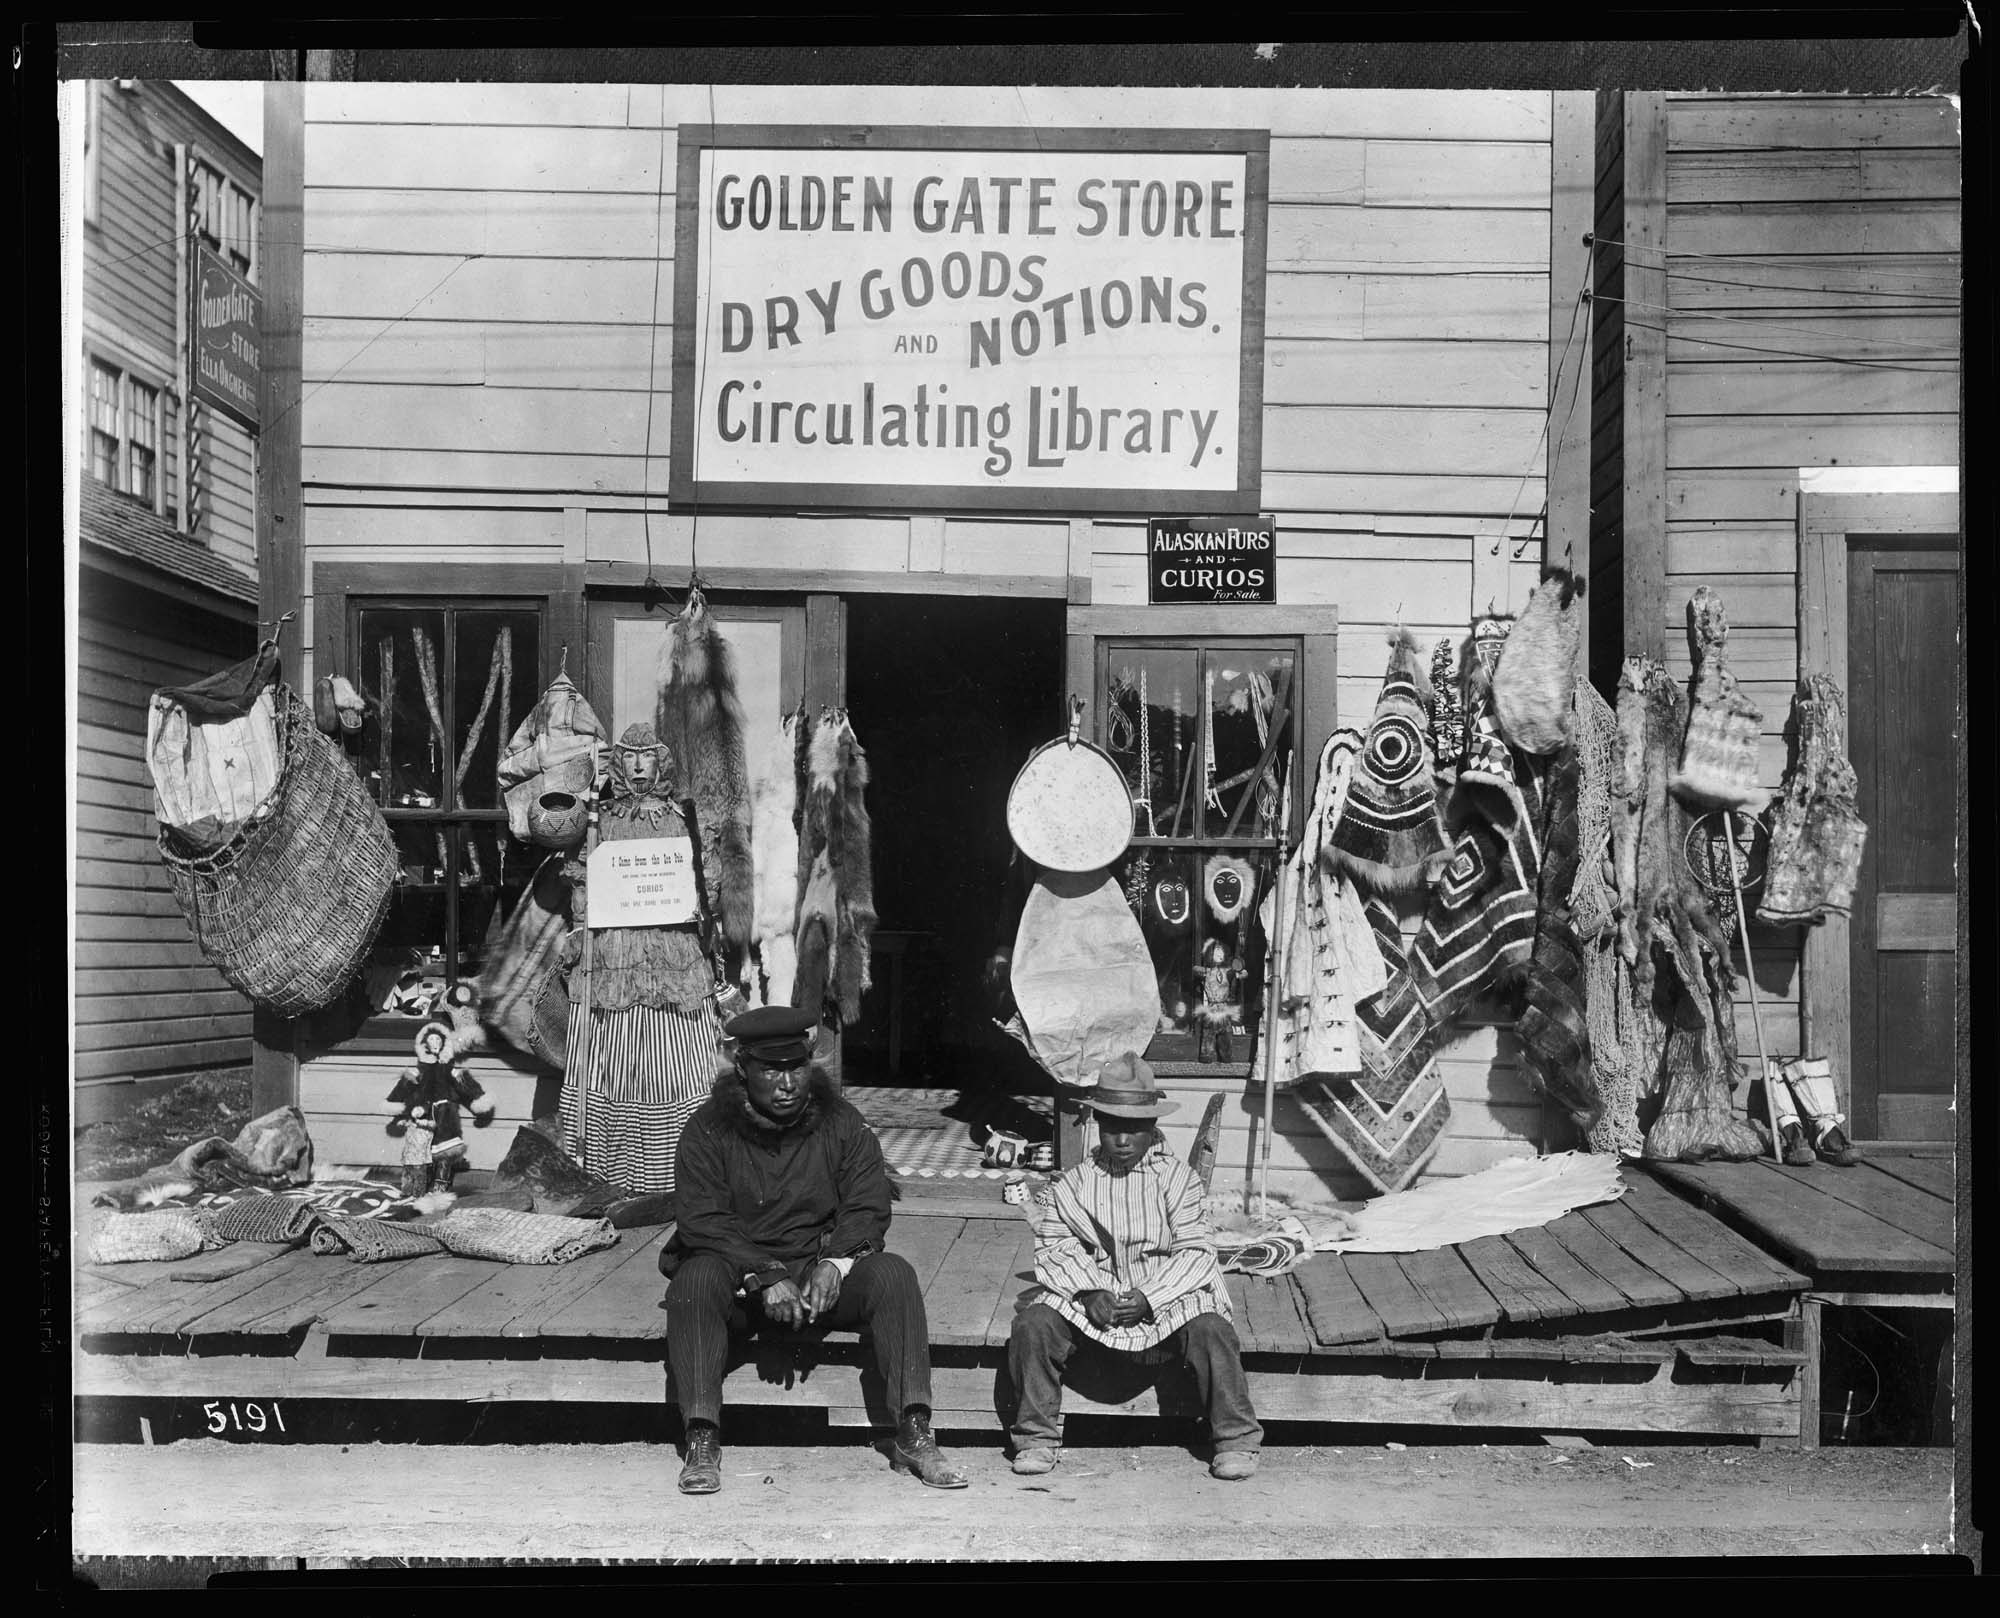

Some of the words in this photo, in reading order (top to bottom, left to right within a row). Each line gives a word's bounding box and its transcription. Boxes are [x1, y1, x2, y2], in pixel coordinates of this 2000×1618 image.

[716, 174, 894, 232] GOLDEN
[912, 176, 1057, 236] GATE
[201, 278, 231, 329] GOLDEN
[231, 282, 255, 328] GATE
[720, 279, 842, 354] DRY
[859, 250, 1048, 320] GOODS
[894, 333, 939, 354] AND
[968, 275, 1222, 369] NOTIONS.
[231, 331, 260, 371] STORE
[716, 379, 1013, 477] Circulating
[1027, 385, 1224, 469] Library.
[1153, 529, 1226, 552] ALASKAN
[1226, 528, 1270, 551] FURS
[1195, 555, 1226, 564] AND
[1160, 568, 1265, 591] CURIOS
[1213, 589, 1233, 600] For
